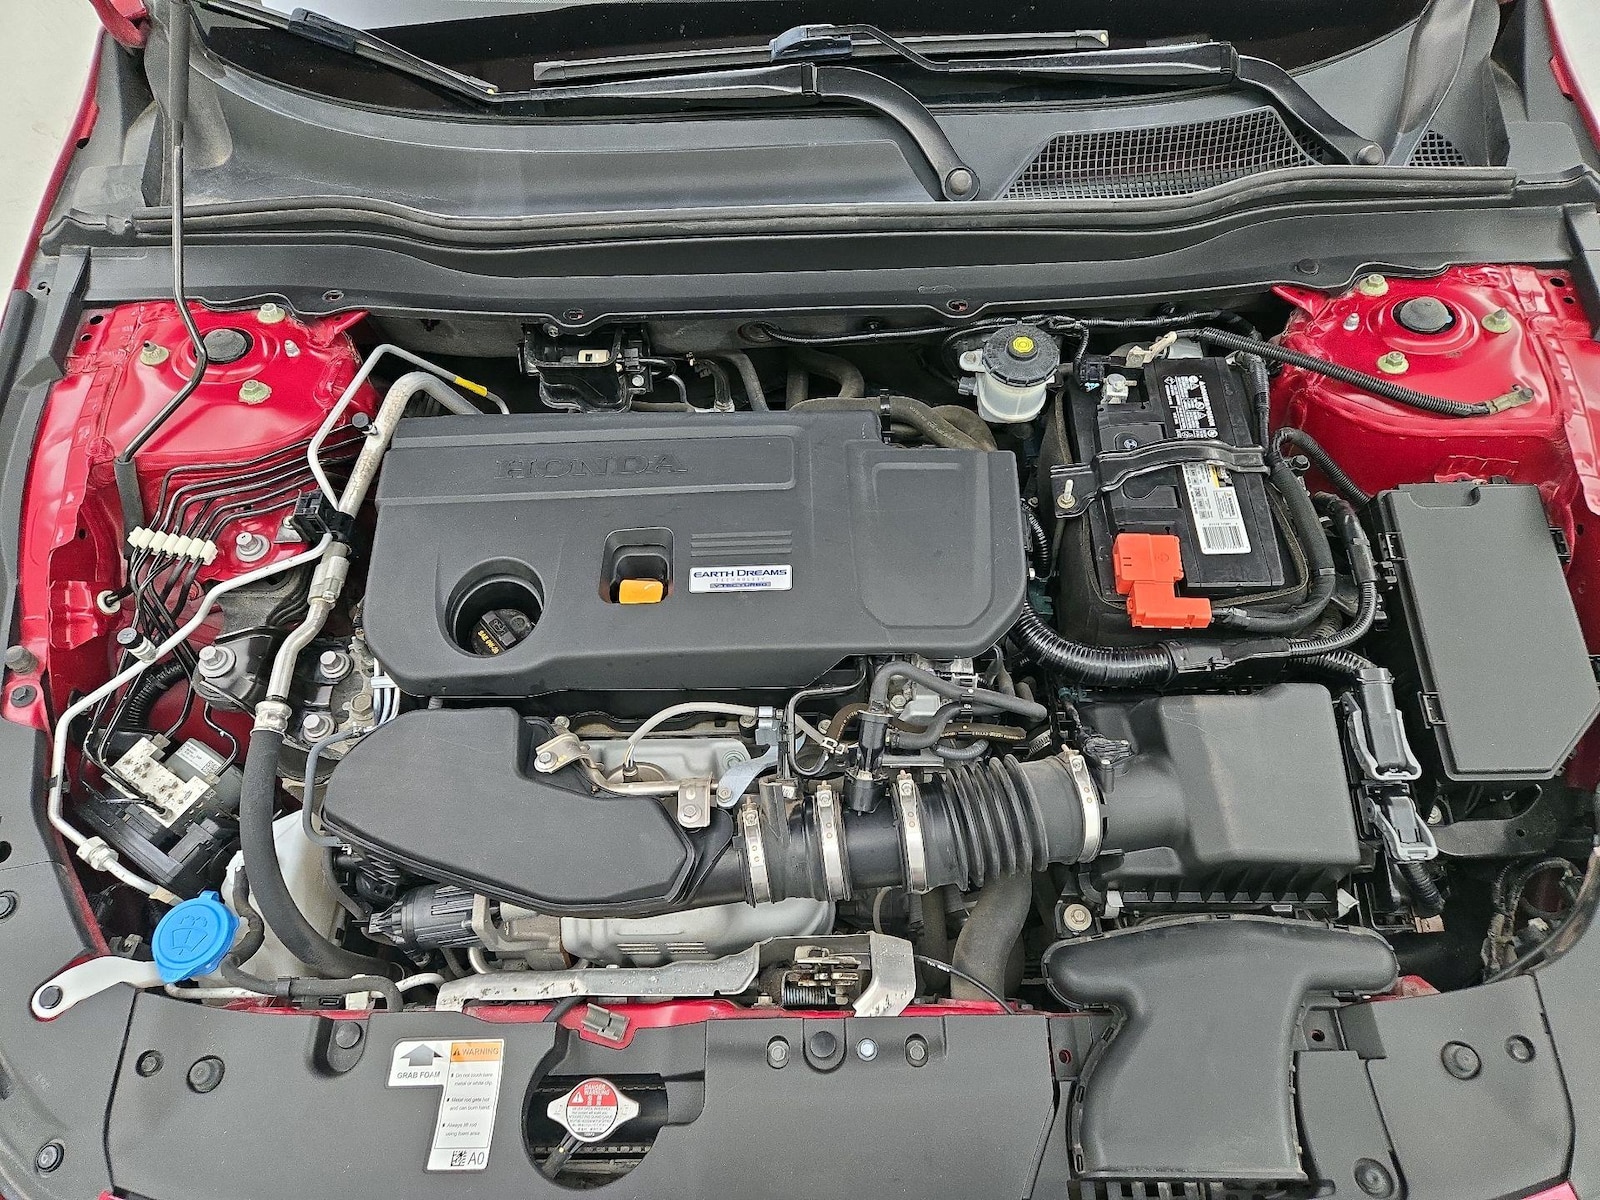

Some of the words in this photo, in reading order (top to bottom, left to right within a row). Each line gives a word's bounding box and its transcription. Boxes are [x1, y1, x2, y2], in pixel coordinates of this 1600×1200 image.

[493, 453, 689, 479] HONDA
[693, 570, 734, 579] EARTH
[737, 569, 788, 577] DREAMS
[462, 1047, 499, 1056] WARNING
[396, 1071, 418, 1079] GRAB
[419, 1070, 441, 1079] FOAM
